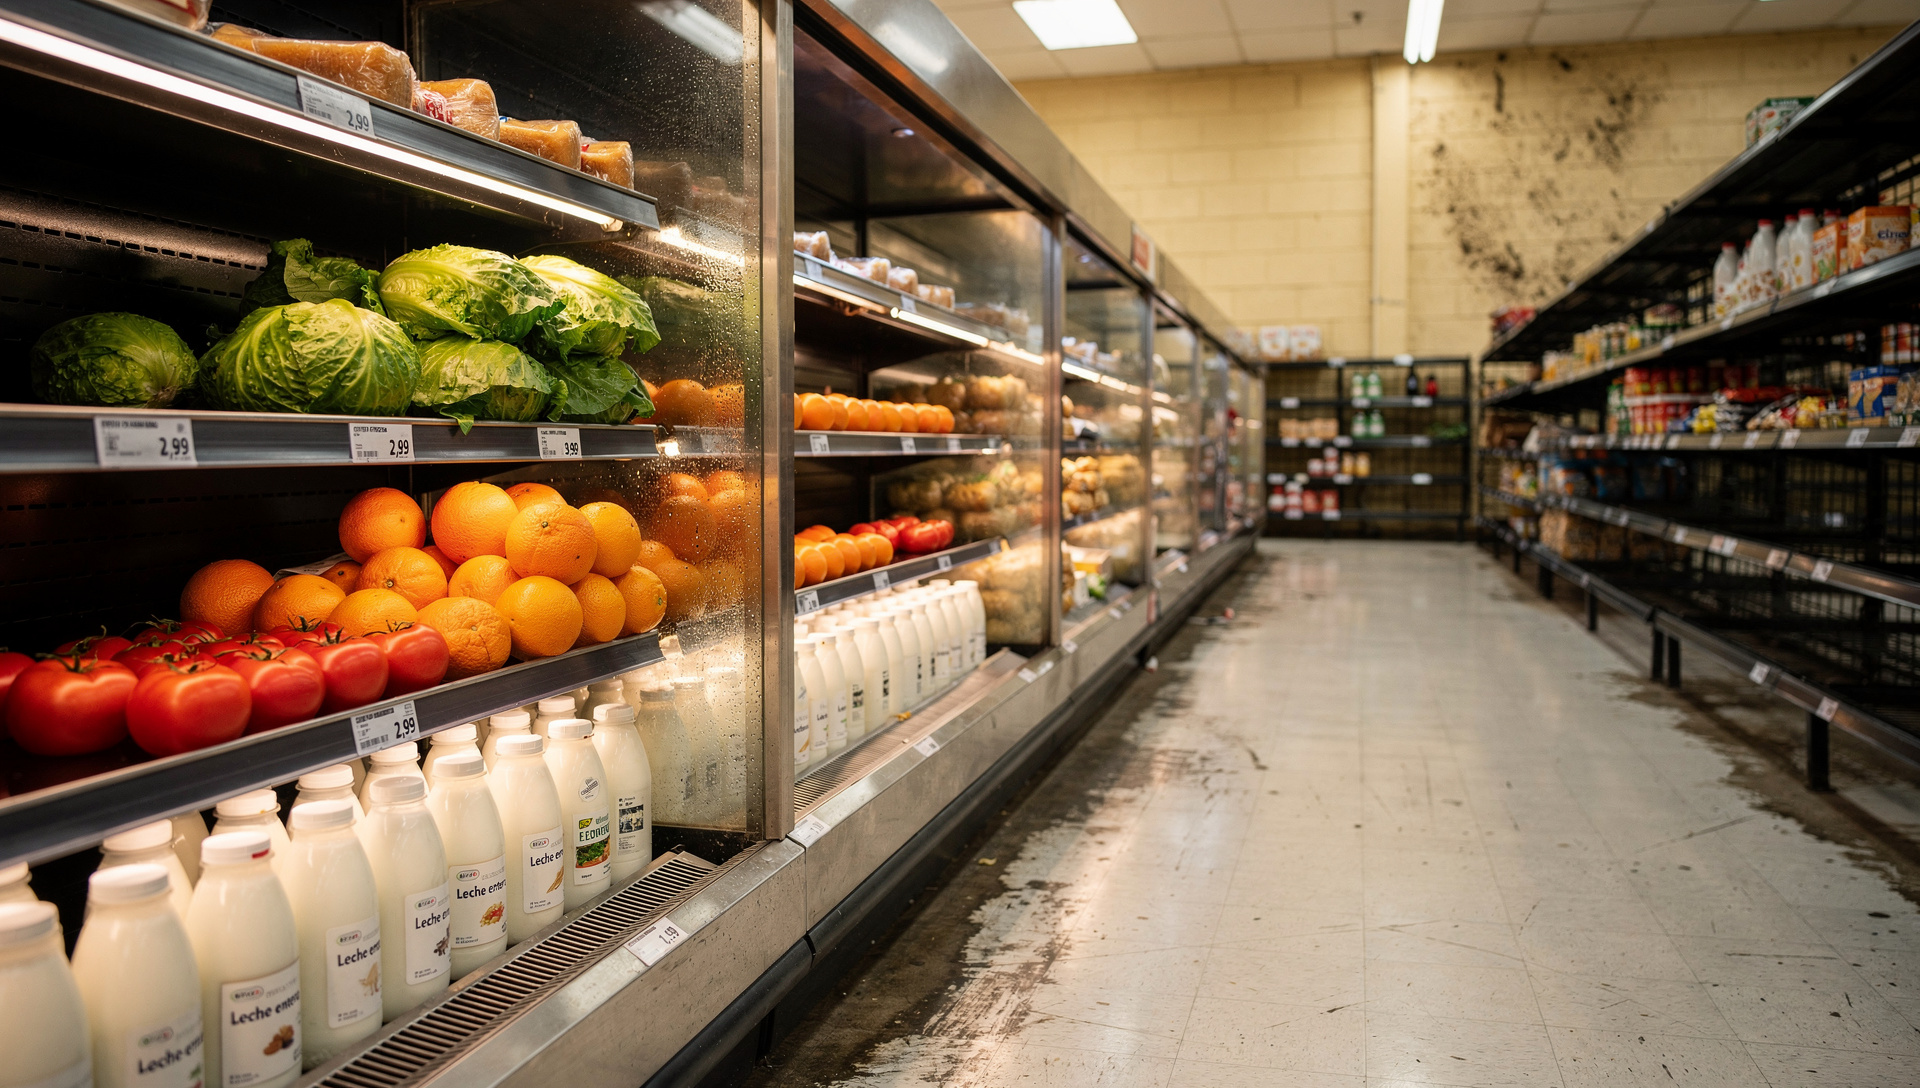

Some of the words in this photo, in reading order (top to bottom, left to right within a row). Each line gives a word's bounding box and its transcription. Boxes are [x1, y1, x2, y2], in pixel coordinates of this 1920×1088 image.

[346, 109, 369, 132] 2,99
[159, 436, 190, 460] 2,99
[389, 439, 410, 459] 2,99
[394, 716, 416, 739] 2,99
[530, 852, 555, 868] Leche
[457, 885, 487, 900] Leche
[415, 912, 441, 930] Leche
[337, 947, 368, 967] Leche
[231, 1005, 273, 1026] Leche
[138, 1048, 184, 1075] Leche
